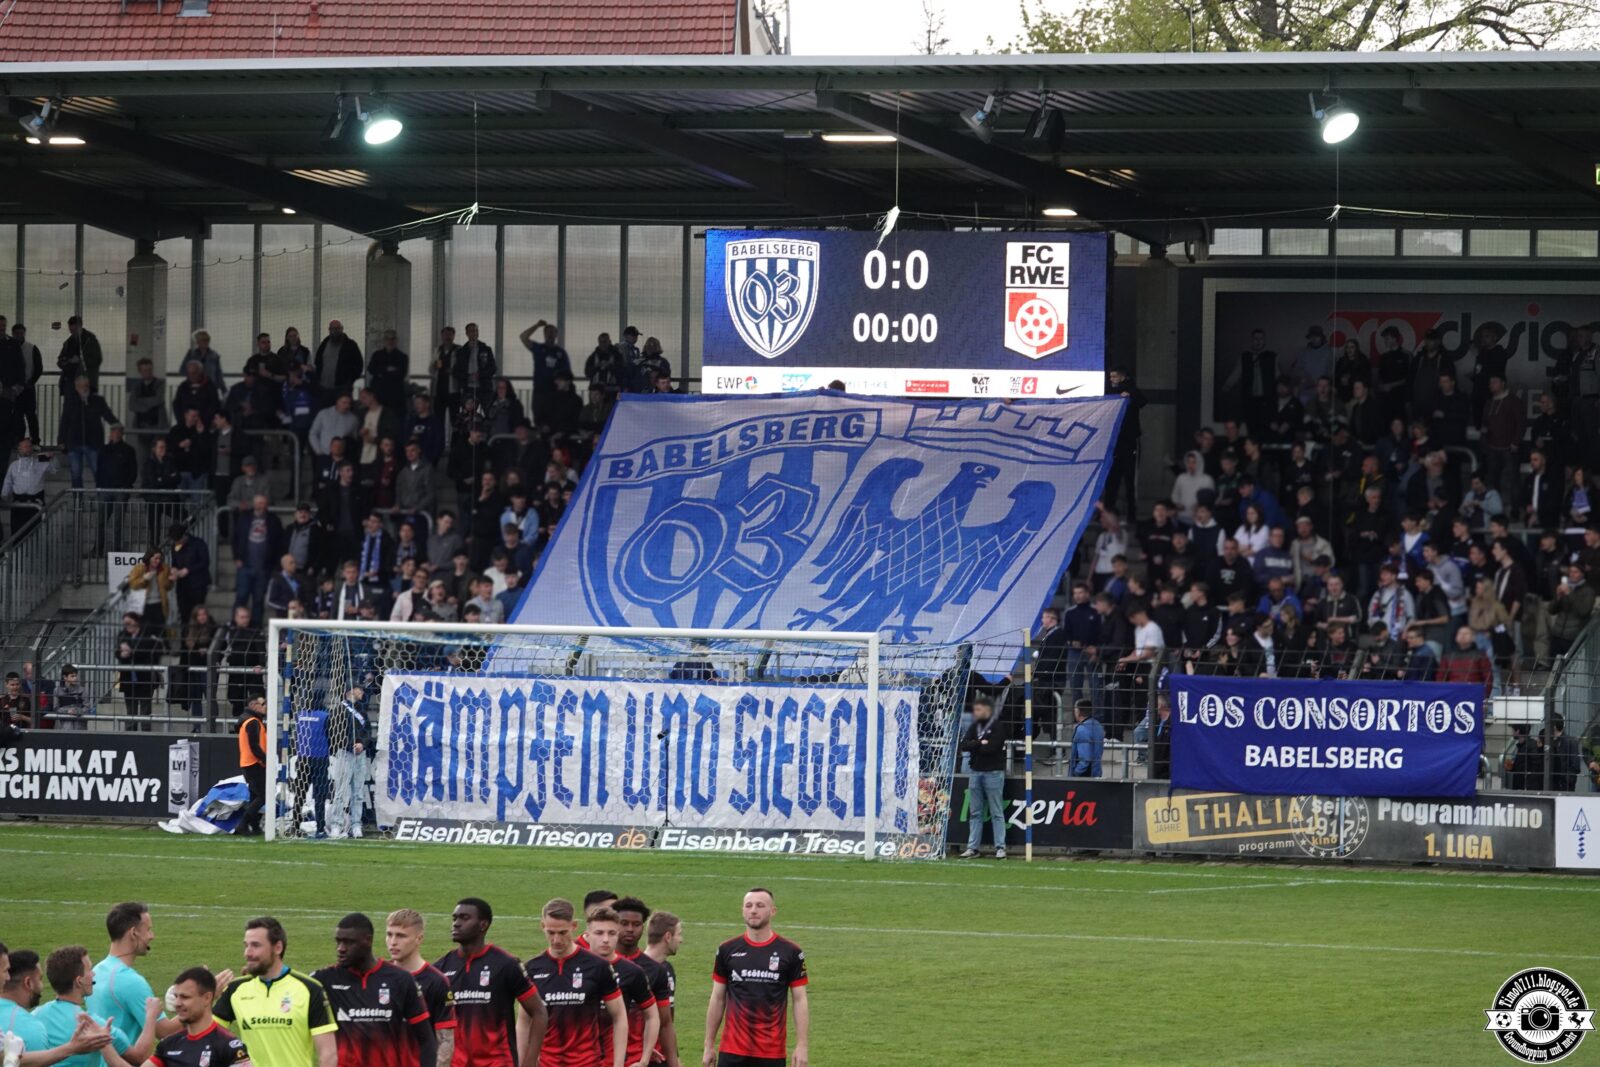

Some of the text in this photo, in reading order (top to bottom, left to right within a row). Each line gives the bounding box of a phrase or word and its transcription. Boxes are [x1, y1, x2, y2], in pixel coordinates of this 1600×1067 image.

[731, 243, 814, 258] BABELSBERG
[1021, 245, 1054, 265] FC
[863, 249, 929, 290] 0:0
[1009, 265, 1065, 285] RWE
[739, 269, 801, 324] 03
[852, 312, 938, 343] 00:00
[716, 376, 743, 390] EWP
[607, 411, 867, 481] BABELSBERG
[1177, 691, 1476, 735] LOS CONSORTOS
[24, 748, 82, 774] MILK
[86, 749, 117, 775] AT
[121, 750, 138, 776] A
[172, 760, 186, 771] LY!
[1244, 744, 1404, 771] BABELSBERG
[45, 775, 161, 803] ANYWAY?
[1153, 808, 1180, 824] 100
[1194, 797, 1304, 830] THALIA
[1311, 797, 1352, 816] seit
[1377, 797, 1543, 829] Programmkino
[395, 820, 520, 845] Eisenbach
[1154, 823, 1182, 833] JAHRE
[659, 829, 797, 854] Eisenbach
[1238, 836, 1338, 853] programm kino
[1424, 832, 1494, 860] 1. LIGA
